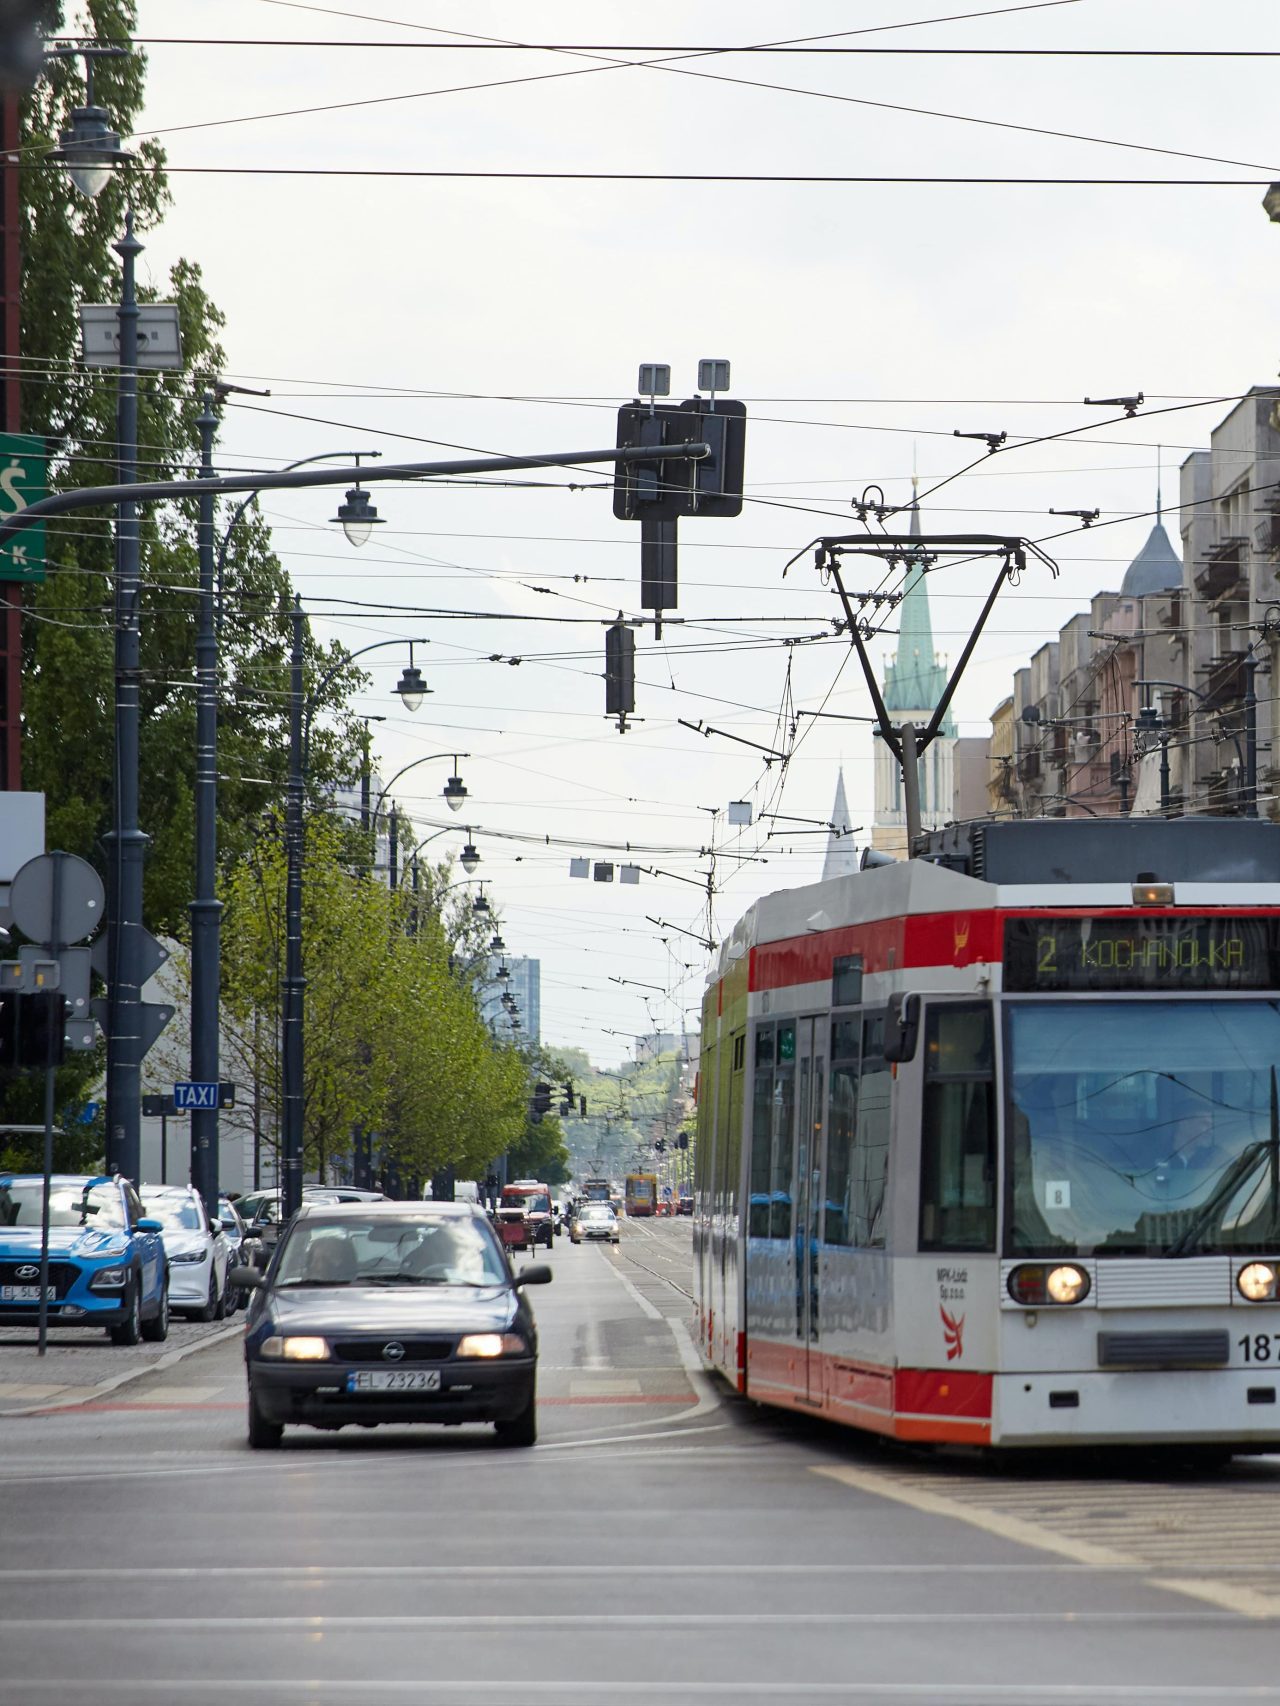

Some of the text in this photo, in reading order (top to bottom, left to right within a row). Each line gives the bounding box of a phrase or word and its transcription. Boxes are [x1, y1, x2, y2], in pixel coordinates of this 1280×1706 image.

[1037, 936, 1057, 972] 2
[176, 1086, 215, 1106] TAXI
[4, 1286, 17, 1298] EL
[357, 1372, 438, 1389] EL 23236
